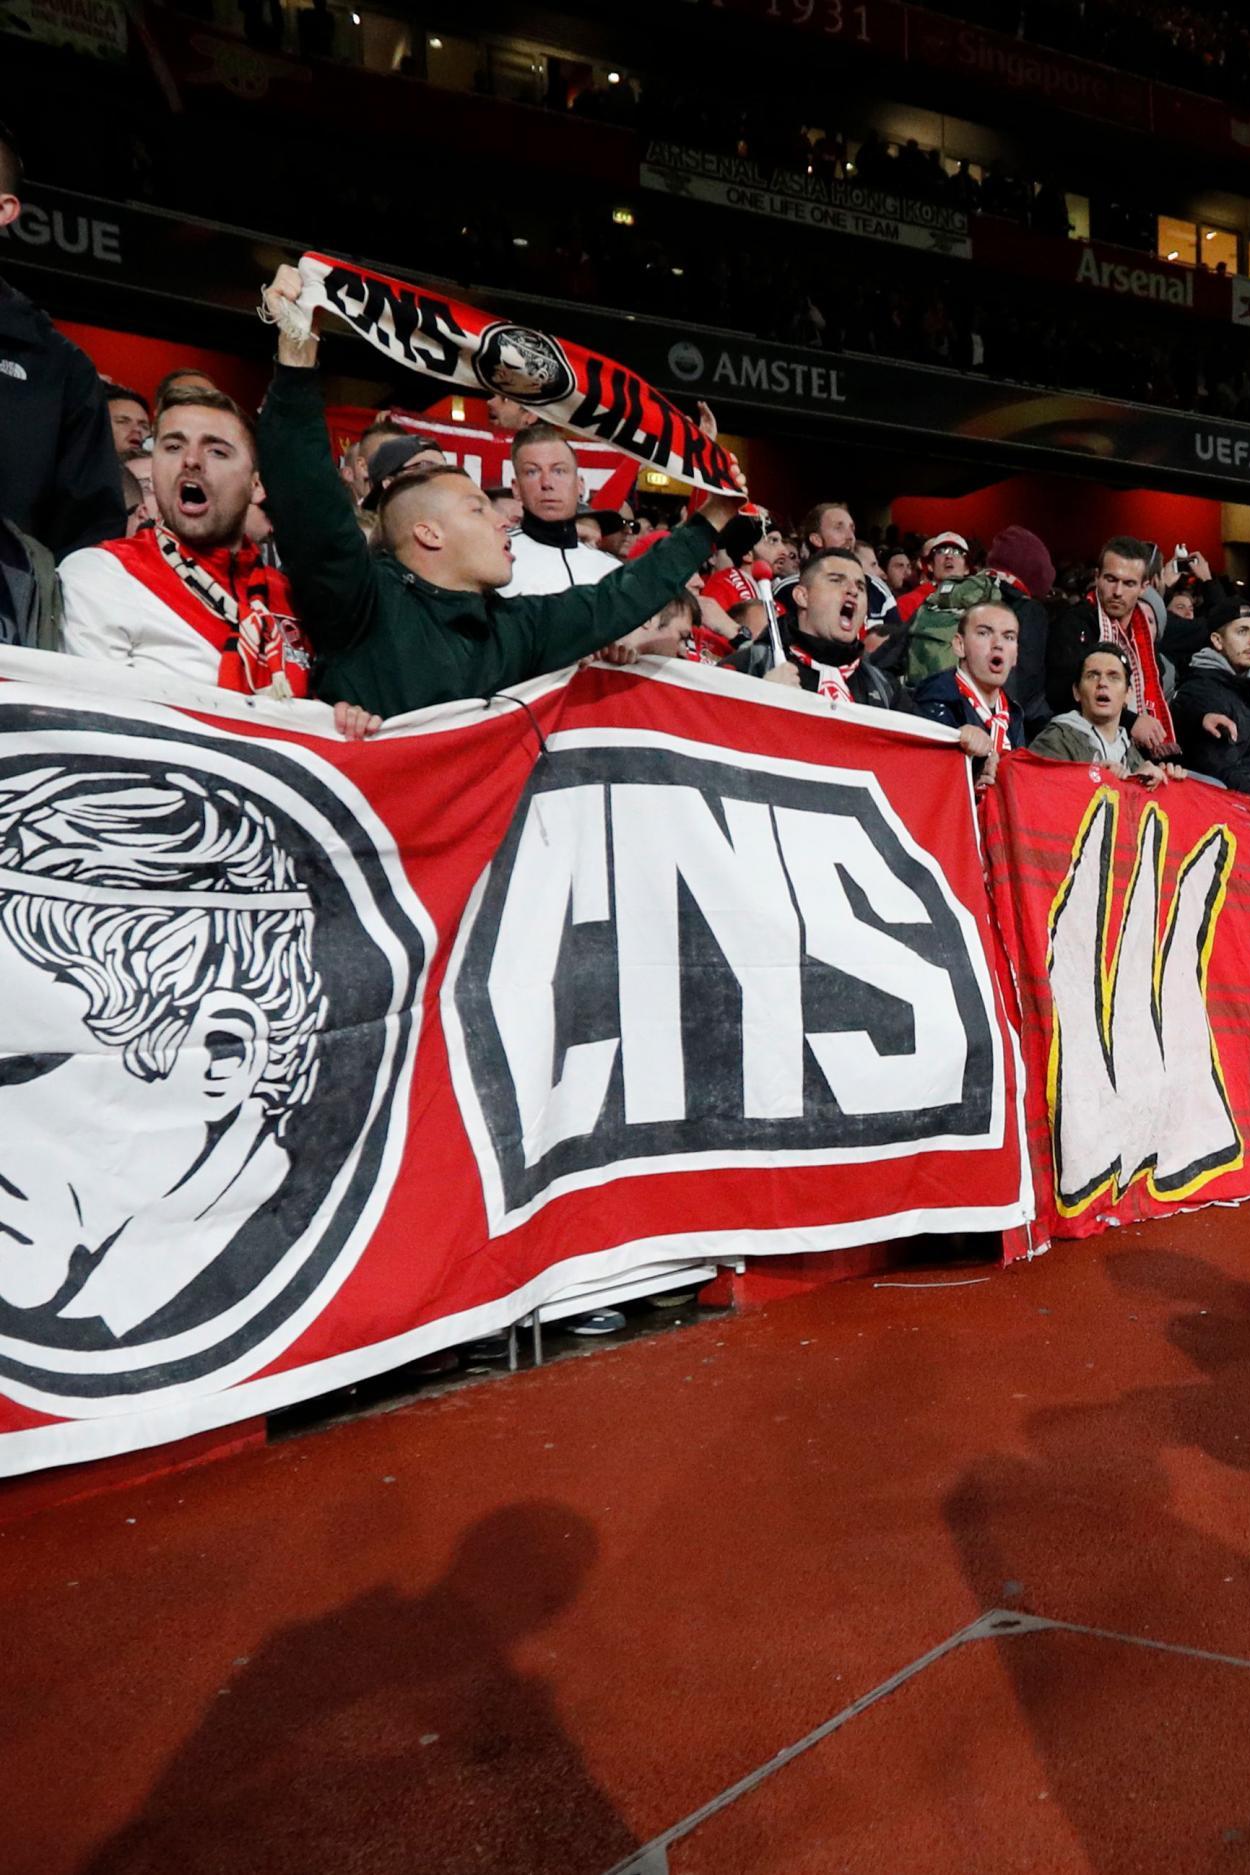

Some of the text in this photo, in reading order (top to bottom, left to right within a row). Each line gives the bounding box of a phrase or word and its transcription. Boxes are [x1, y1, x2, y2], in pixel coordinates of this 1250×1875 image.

[957, 31, 1105, 98] Singapore
[646, 142, 967, 231] ARSENAL ASIA HONG KONG
[726, 186, 900, 240] ONE LIFE ONE TEAM
[1076, 248, 1195, 309] Arsenal
[712, 351, 847, 402] AMSTEL
[487, 782, 968, 1169] CNS
